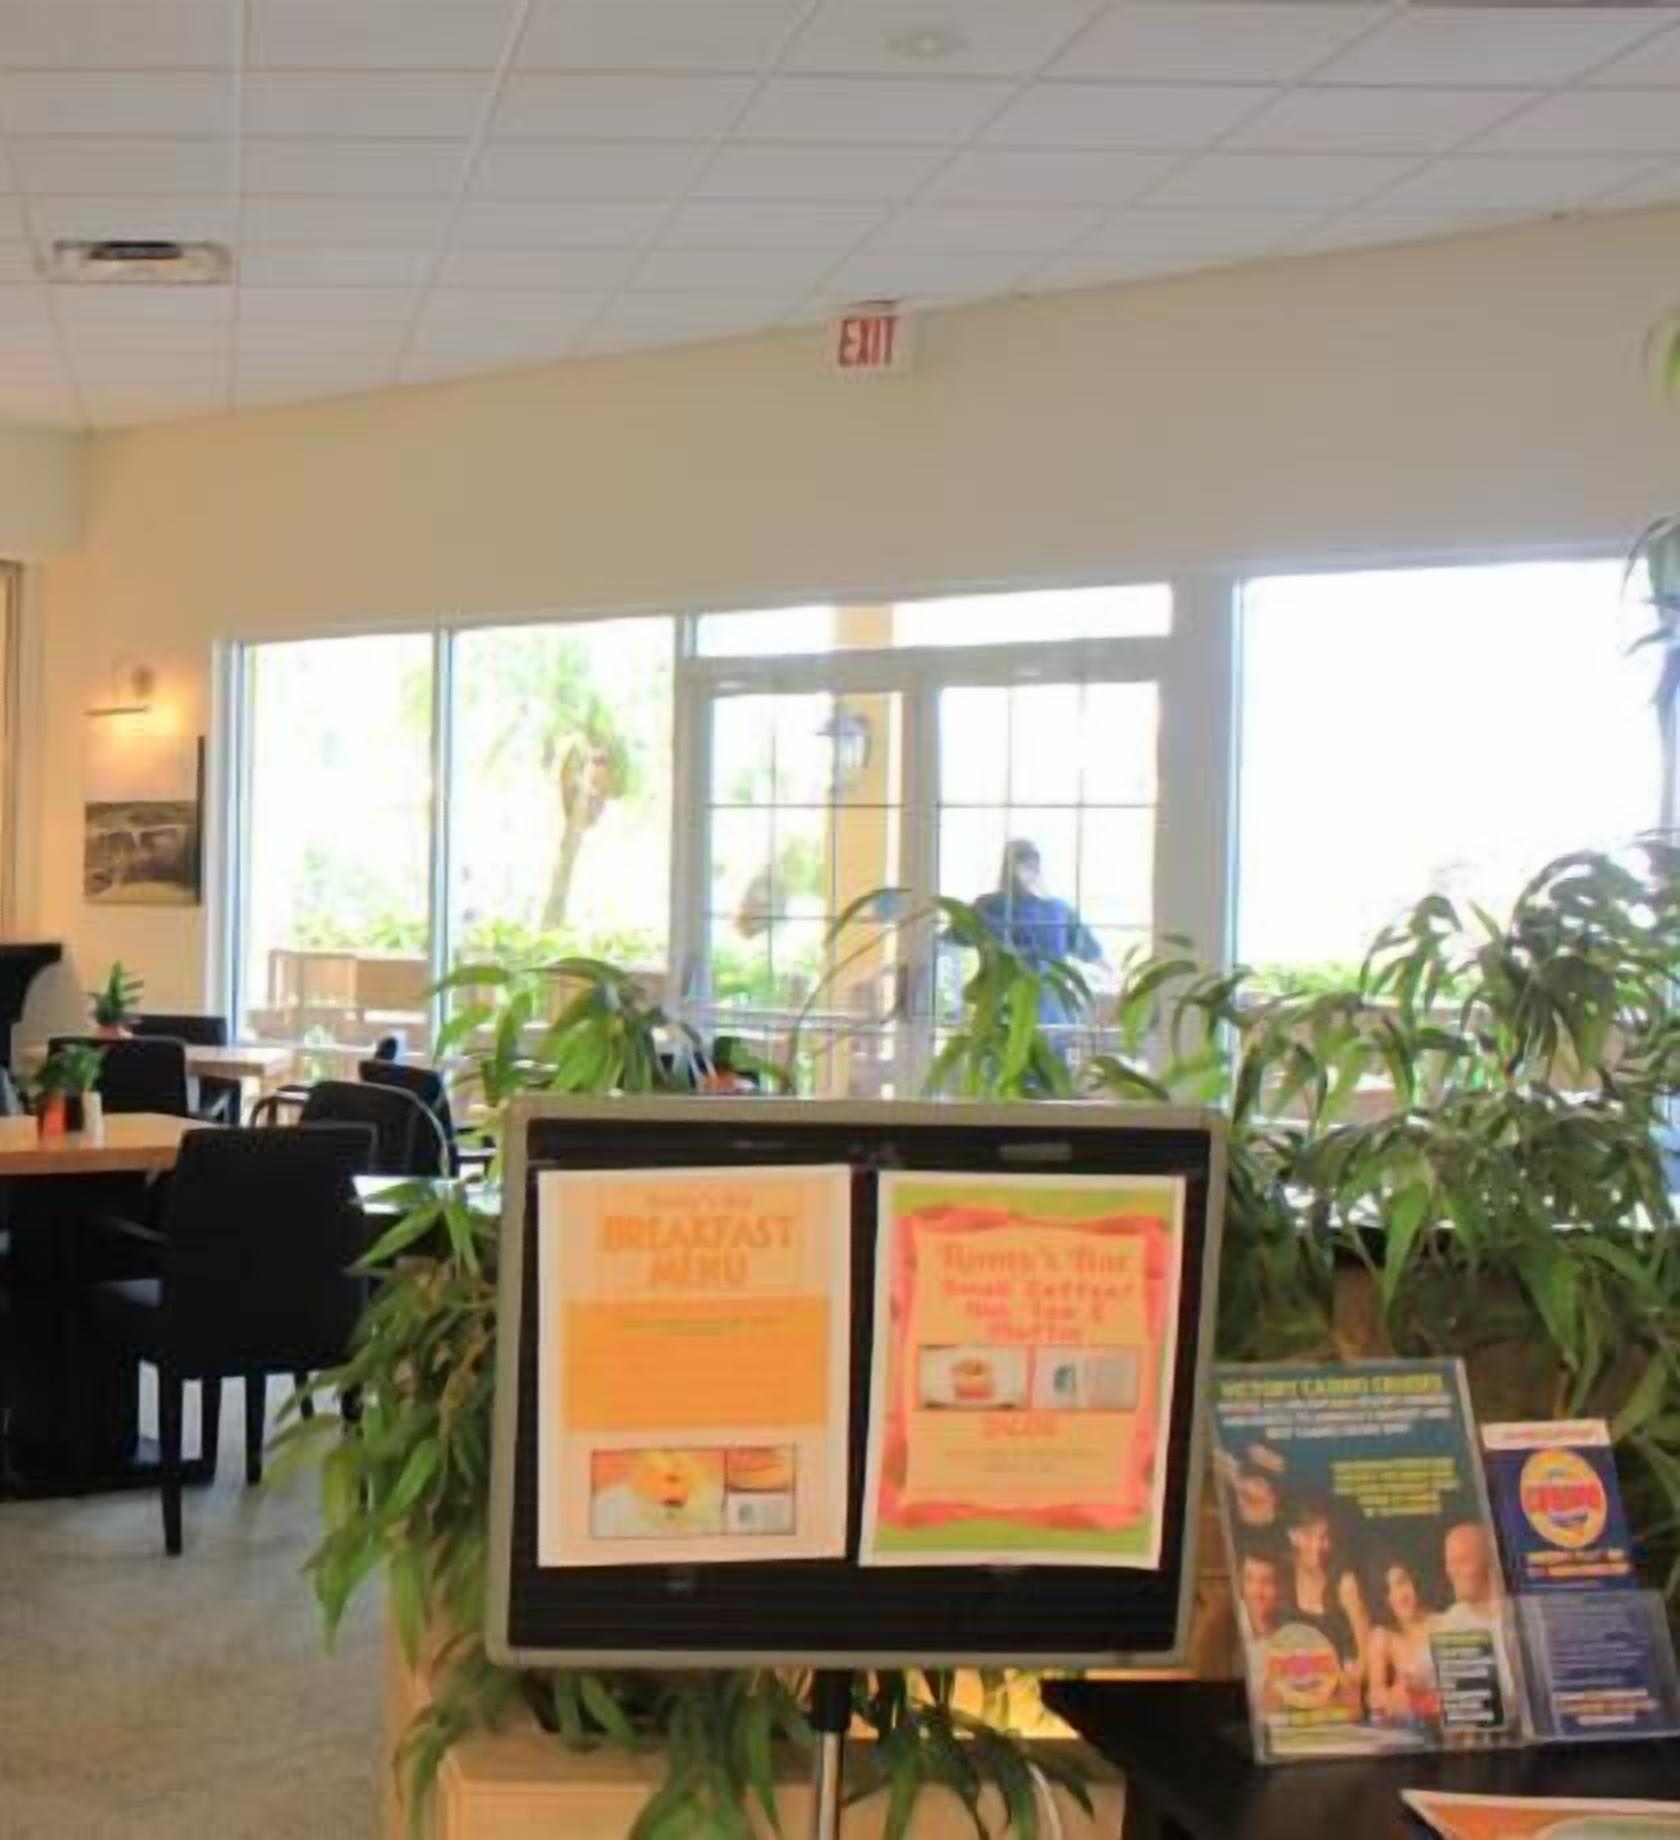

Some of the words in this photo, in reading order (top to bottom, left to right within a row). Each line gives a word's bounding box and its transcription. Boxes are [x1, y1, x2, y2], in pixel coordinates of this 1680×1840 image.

[838, 315, 900, 367] EXIT
[601, 1215, 794, 1250] BREAKFAST
[647, 1251, 750, 1288] MENU
